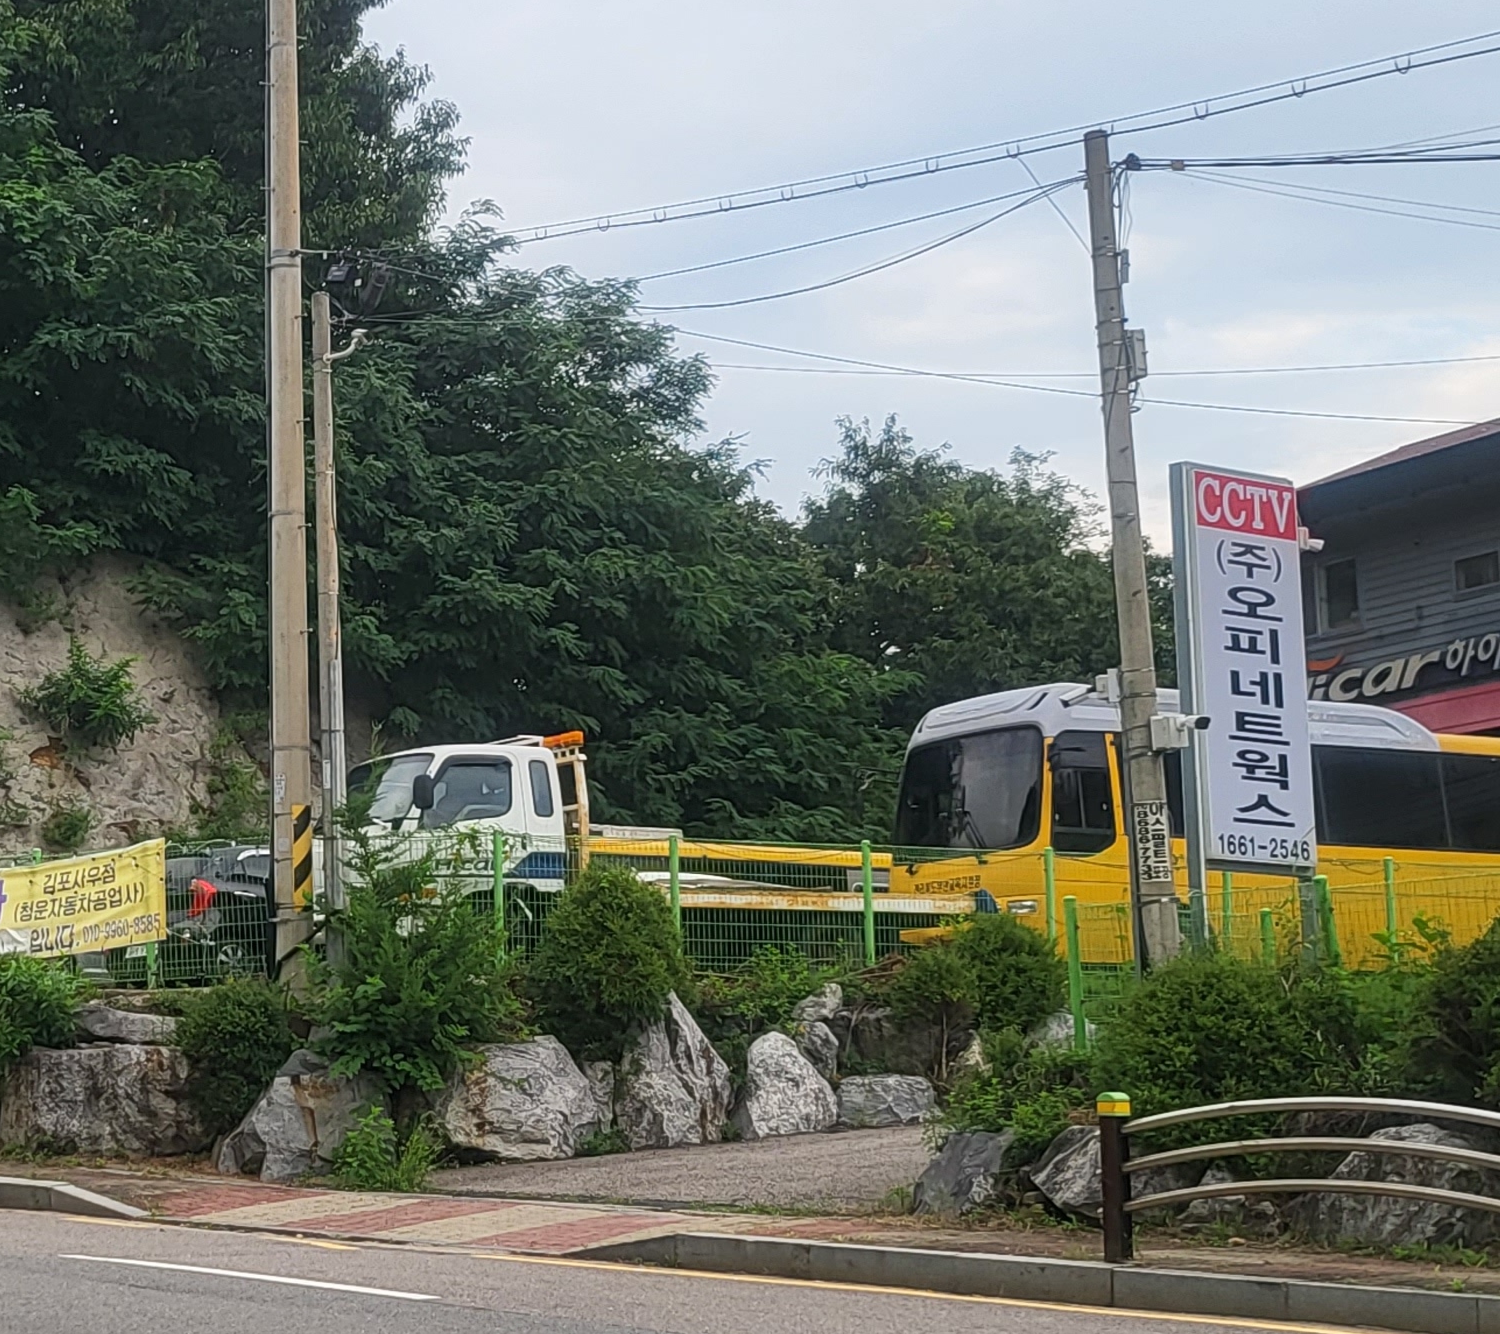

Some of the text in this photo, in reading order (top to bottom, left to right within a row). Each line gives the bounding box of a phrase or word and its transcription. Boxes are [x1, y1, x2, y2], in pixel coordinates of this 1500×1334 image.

[1198, 477, 1292, 533] CCTV
[1307, 650, 1442, 701] icar
[1218, 833, 1310, 861] 1661-2546
[43, 863, 116, 895] 김포사우점
[14, 881, 146, 922] (청운자동차공업사)
